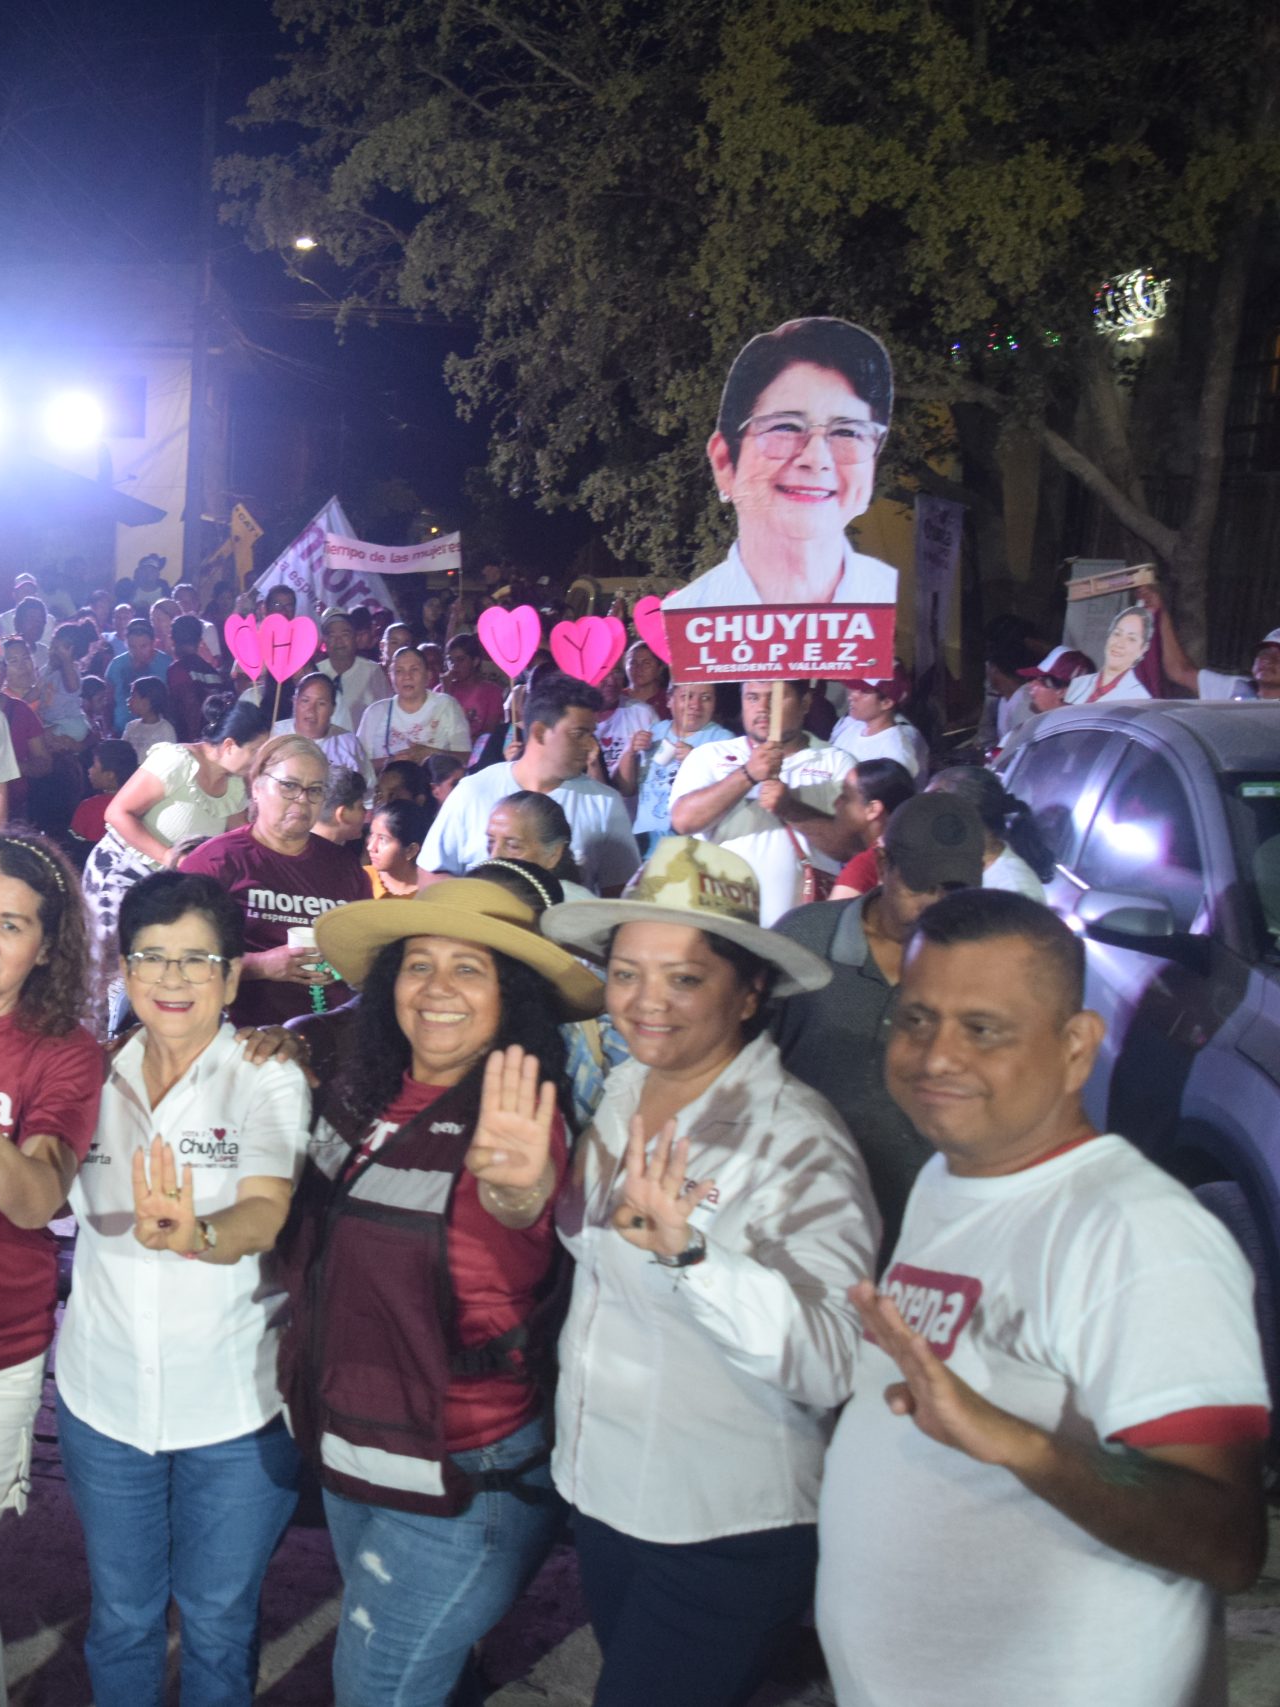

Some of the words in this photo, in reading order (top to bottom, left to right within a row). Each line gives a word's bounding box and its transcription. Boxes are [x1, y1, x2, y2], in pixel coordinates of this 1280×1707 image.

[369, 551, 386, 563] de
[390, 553, 409, 564] las
[685, 613, 874, 644] CHUYITA
[271, 628, 294, 665] H
[490, 620, 521, 664] U
[563, 627, 591, 675] Y
[699, 640, 859, 664] LÓPEZ
[706, 662, 783, 673] PRESIDENTA
[788, 660, 853, 671] VALLARTA
[247, 909, 259, 919] La
[261, 911, 309, 925] esperanza
[179, 1138, 239, 1159] Chuyita
